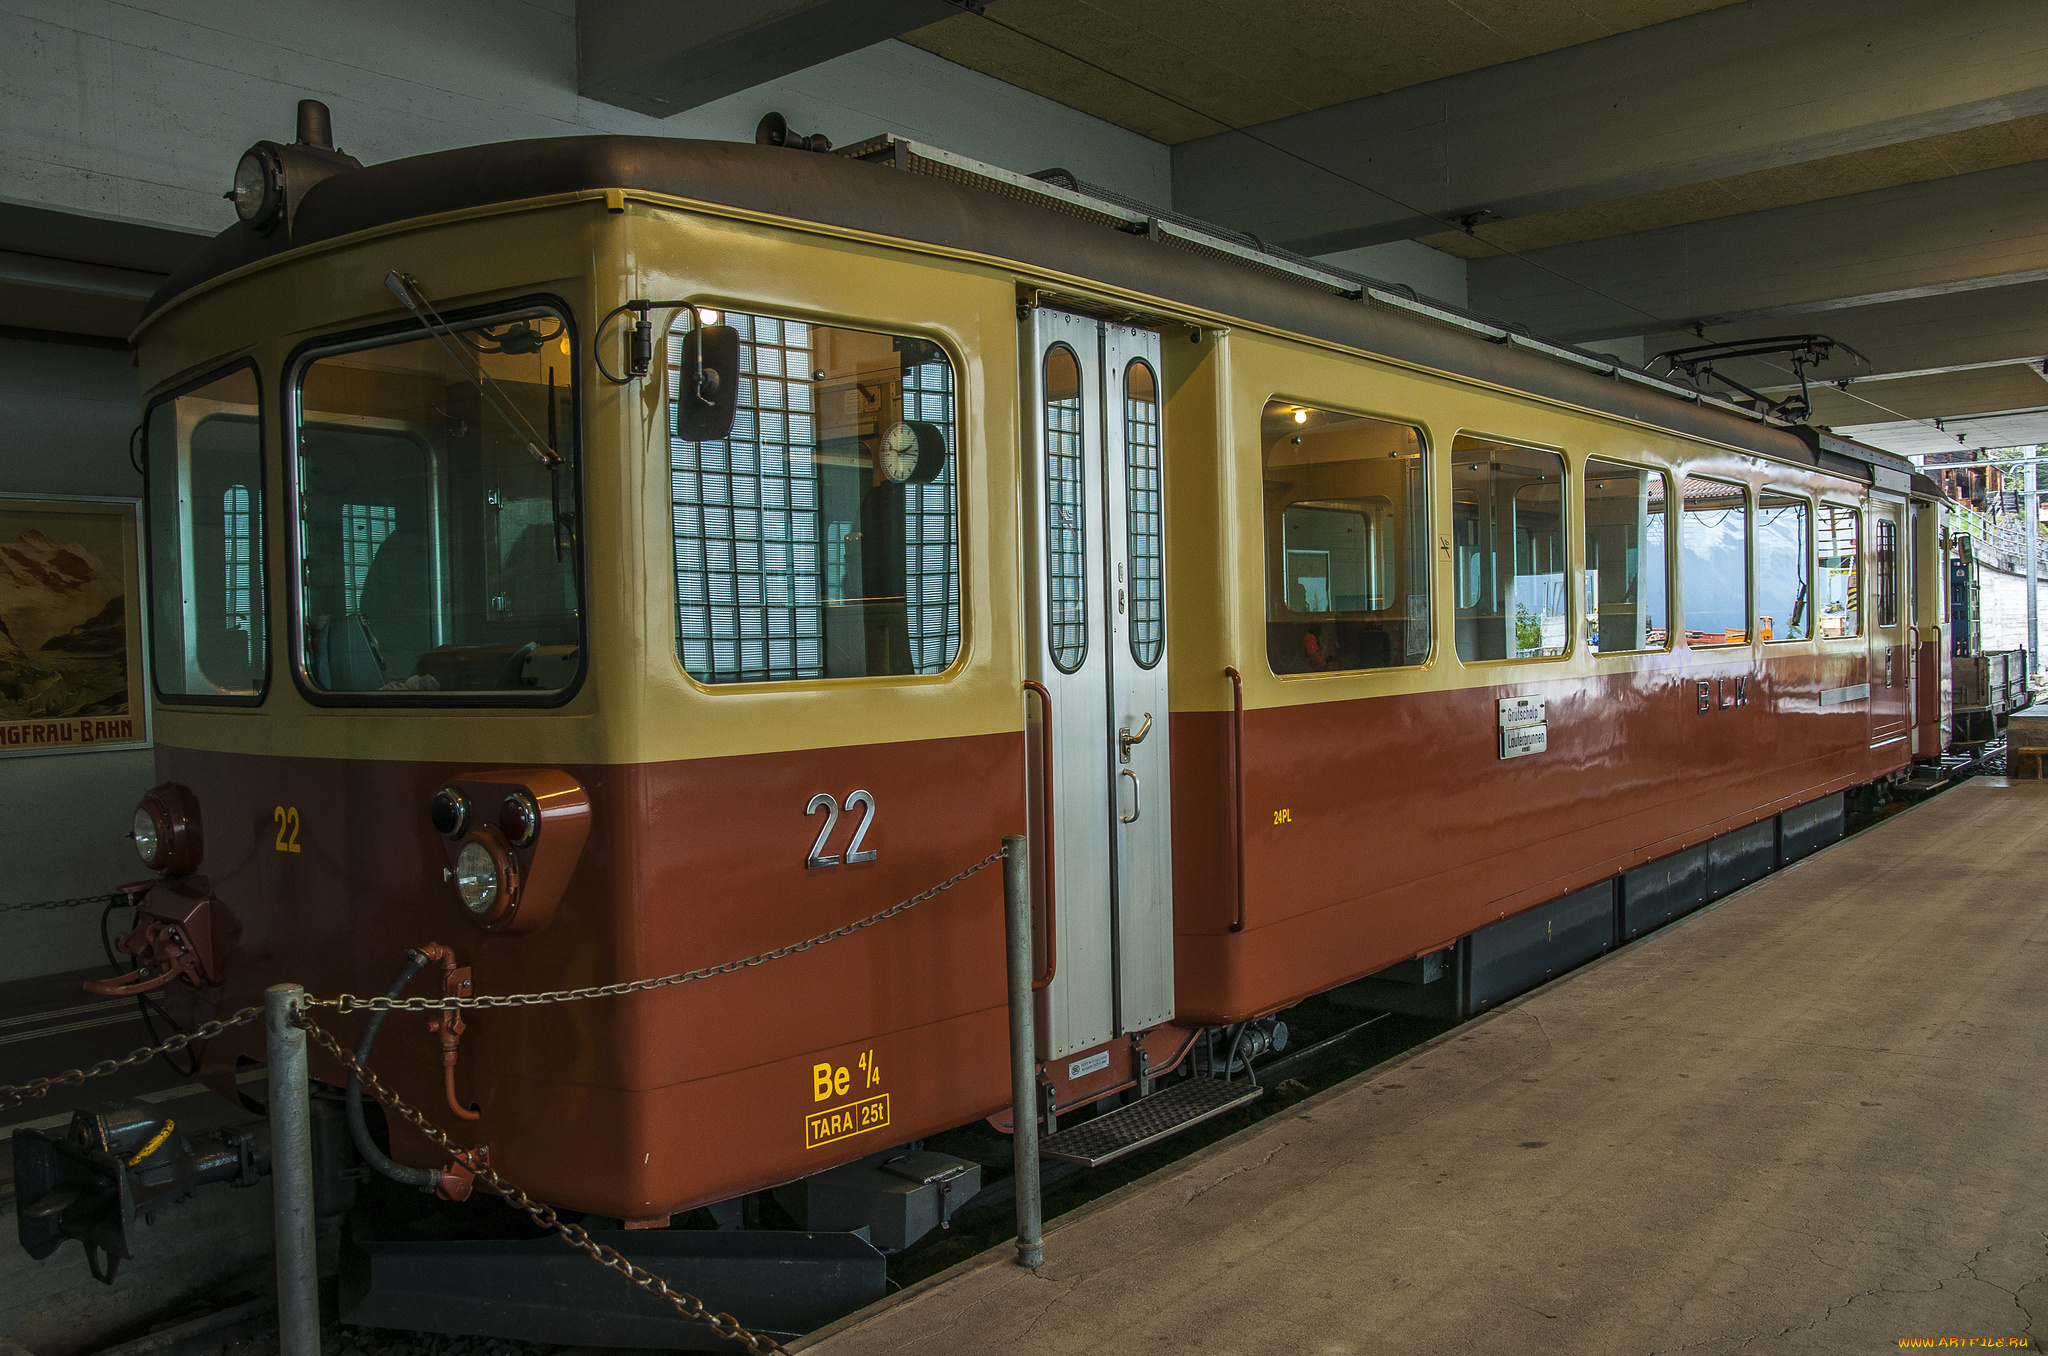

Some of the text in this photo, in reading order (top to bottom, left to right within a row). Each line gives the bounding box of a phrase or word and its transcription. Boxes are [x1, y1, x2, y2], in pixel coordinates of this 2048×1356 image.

[1507, 705, 1539, 722] Grütschalp
[1507, 731, 1545, 749] Lauterbrunnen
[274, 805, 301, 853] 22
[807, 789, 877, 869] 22
[1273, 808, 1292, 825] 24PL
[813, 1049, 880, 1103] Be 4/4
[811, 1102, 884, 1140] TARA 25t
